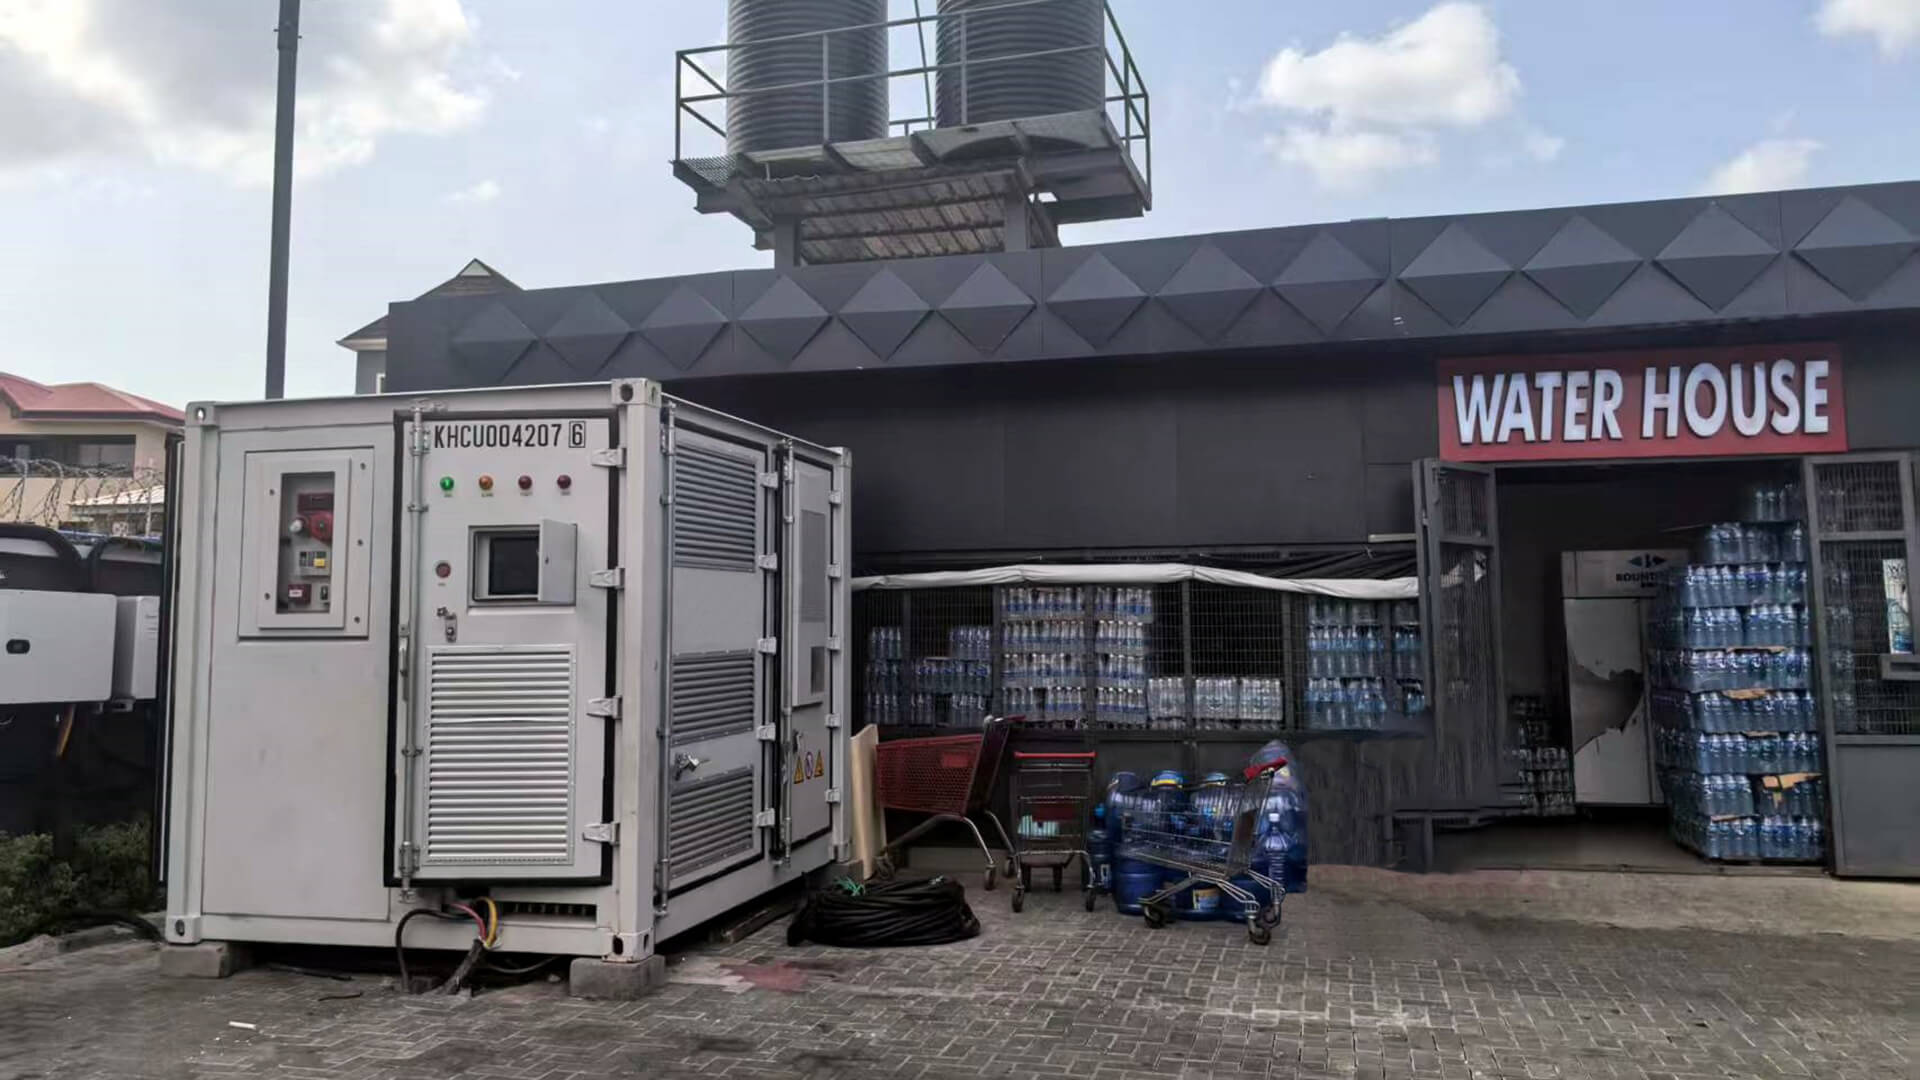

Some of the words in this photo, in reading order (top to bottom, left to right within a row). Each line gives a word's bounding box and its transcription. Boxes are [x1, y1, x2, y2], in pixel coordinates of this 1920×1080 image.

[1452, 368, 1624, 444] WATER
[1641, 358, 1830, 439] HOUSE
[434, 423, 562, 449] KHCU004207
[572, 423, 583, 446] 6
